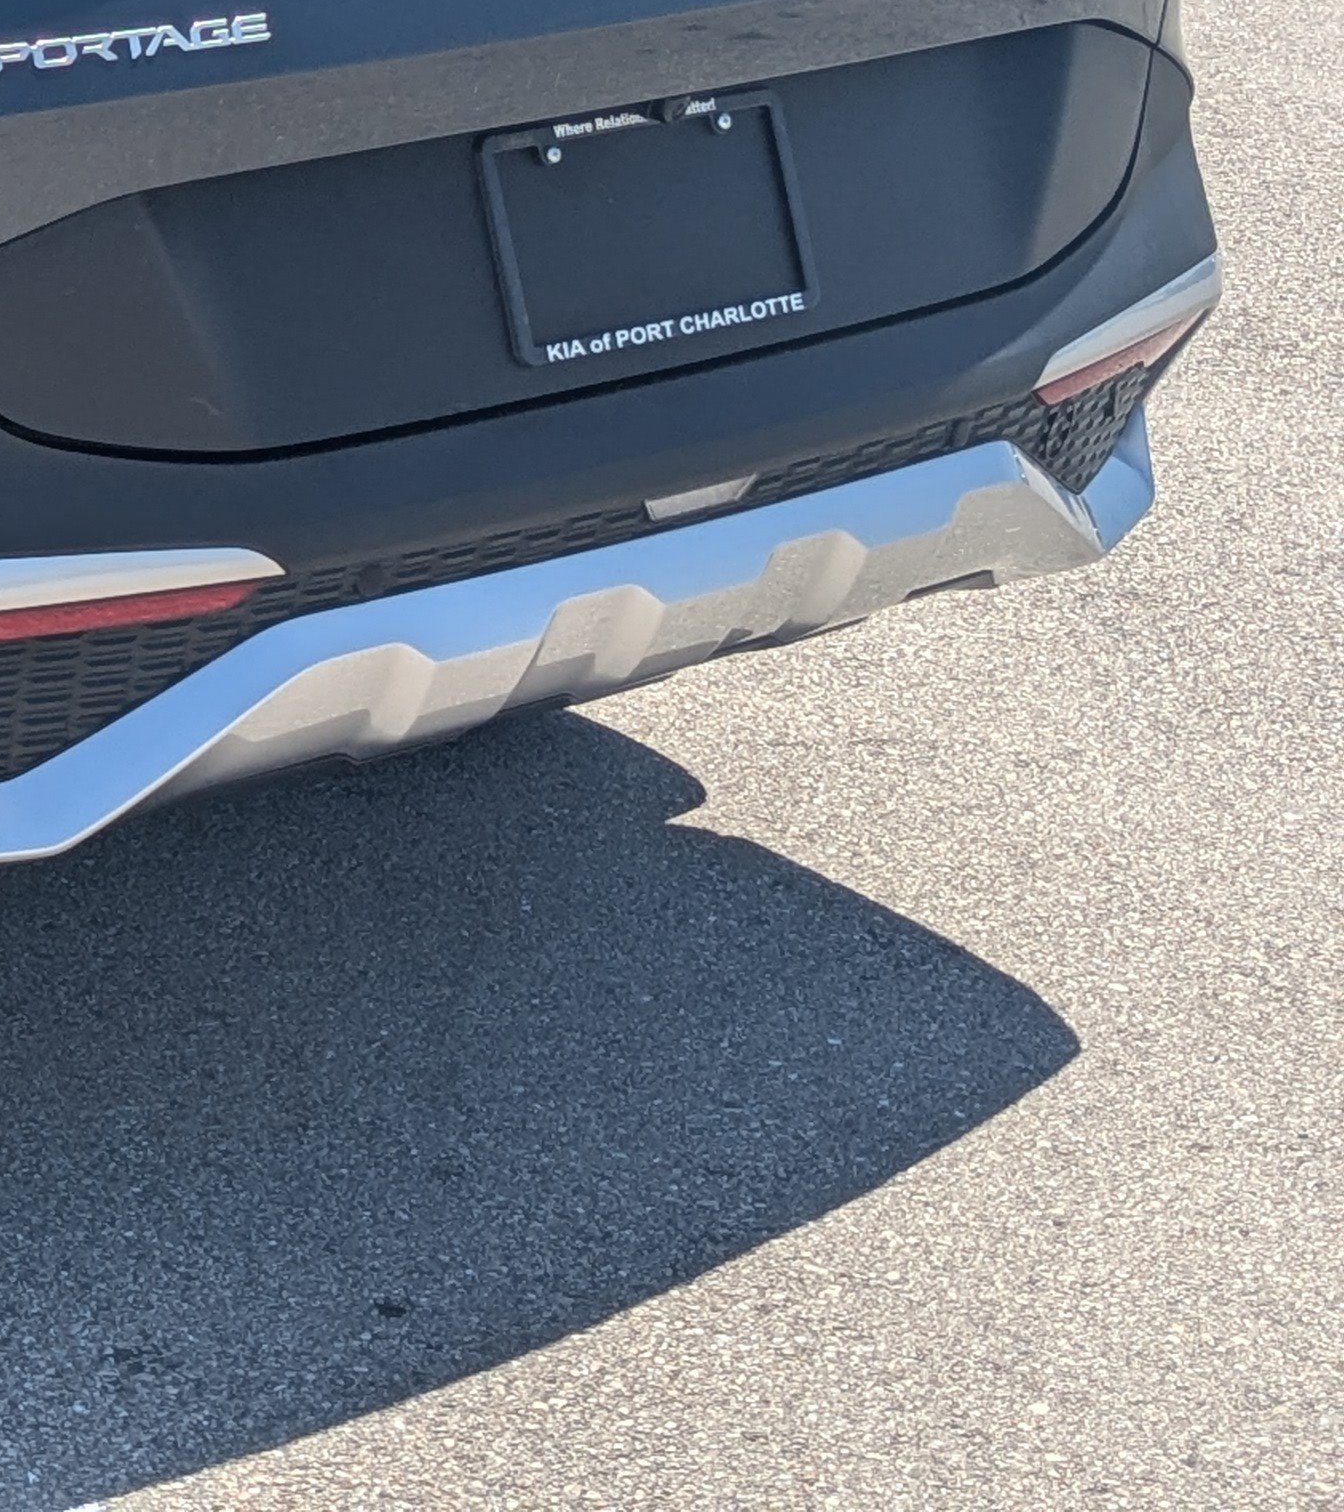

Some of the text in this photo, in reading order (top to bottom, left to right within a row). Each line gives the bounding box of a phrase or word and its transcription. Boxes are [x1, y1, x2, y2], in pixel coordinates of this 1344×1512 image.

[552, 120, 593, 138] Where
[546, 292, 806, 363] KIA of PORT CHARLOTTE
